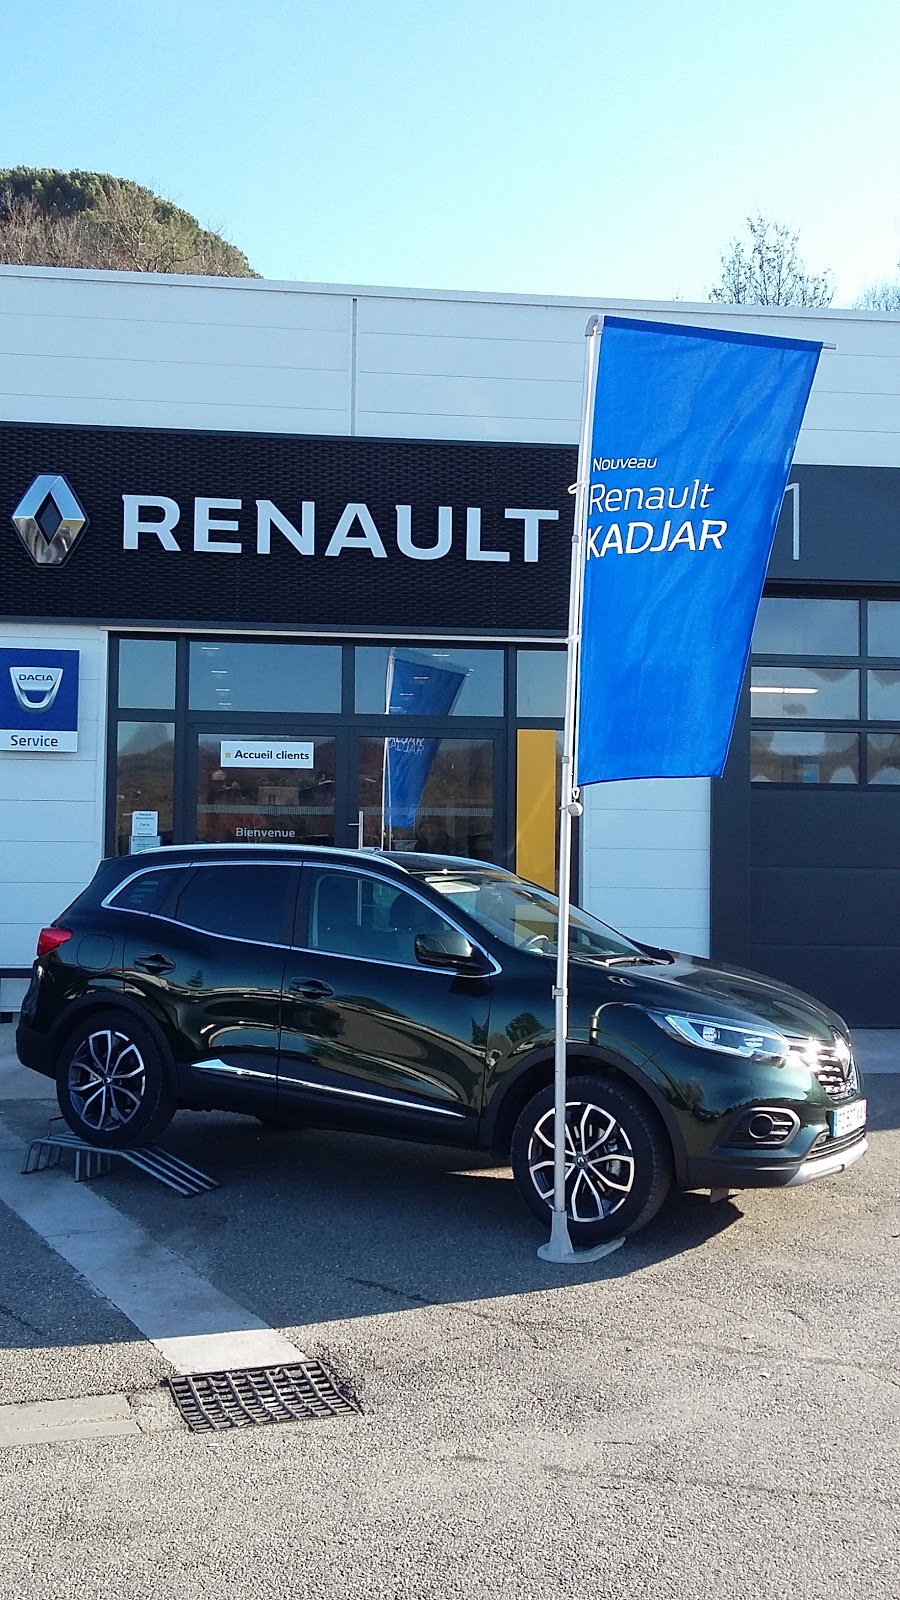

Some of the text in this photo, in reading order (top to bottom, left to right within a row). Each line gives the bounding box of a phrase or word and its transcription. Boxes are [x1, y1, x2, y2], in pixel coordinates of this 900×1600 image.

[592, 456, 658, 473] Nouveau
[588, 478, 715, 516] Renault
[122, 494, 560, 563] RENAULT
[586, 519, 728, 561] KADJAR
[18, 674, 54, 682] DACIA
[10, 734, 59, 747] Service
[234, 749, 310, 760] Accueil clients
[235, 827, 296, 838] Bienvenue
